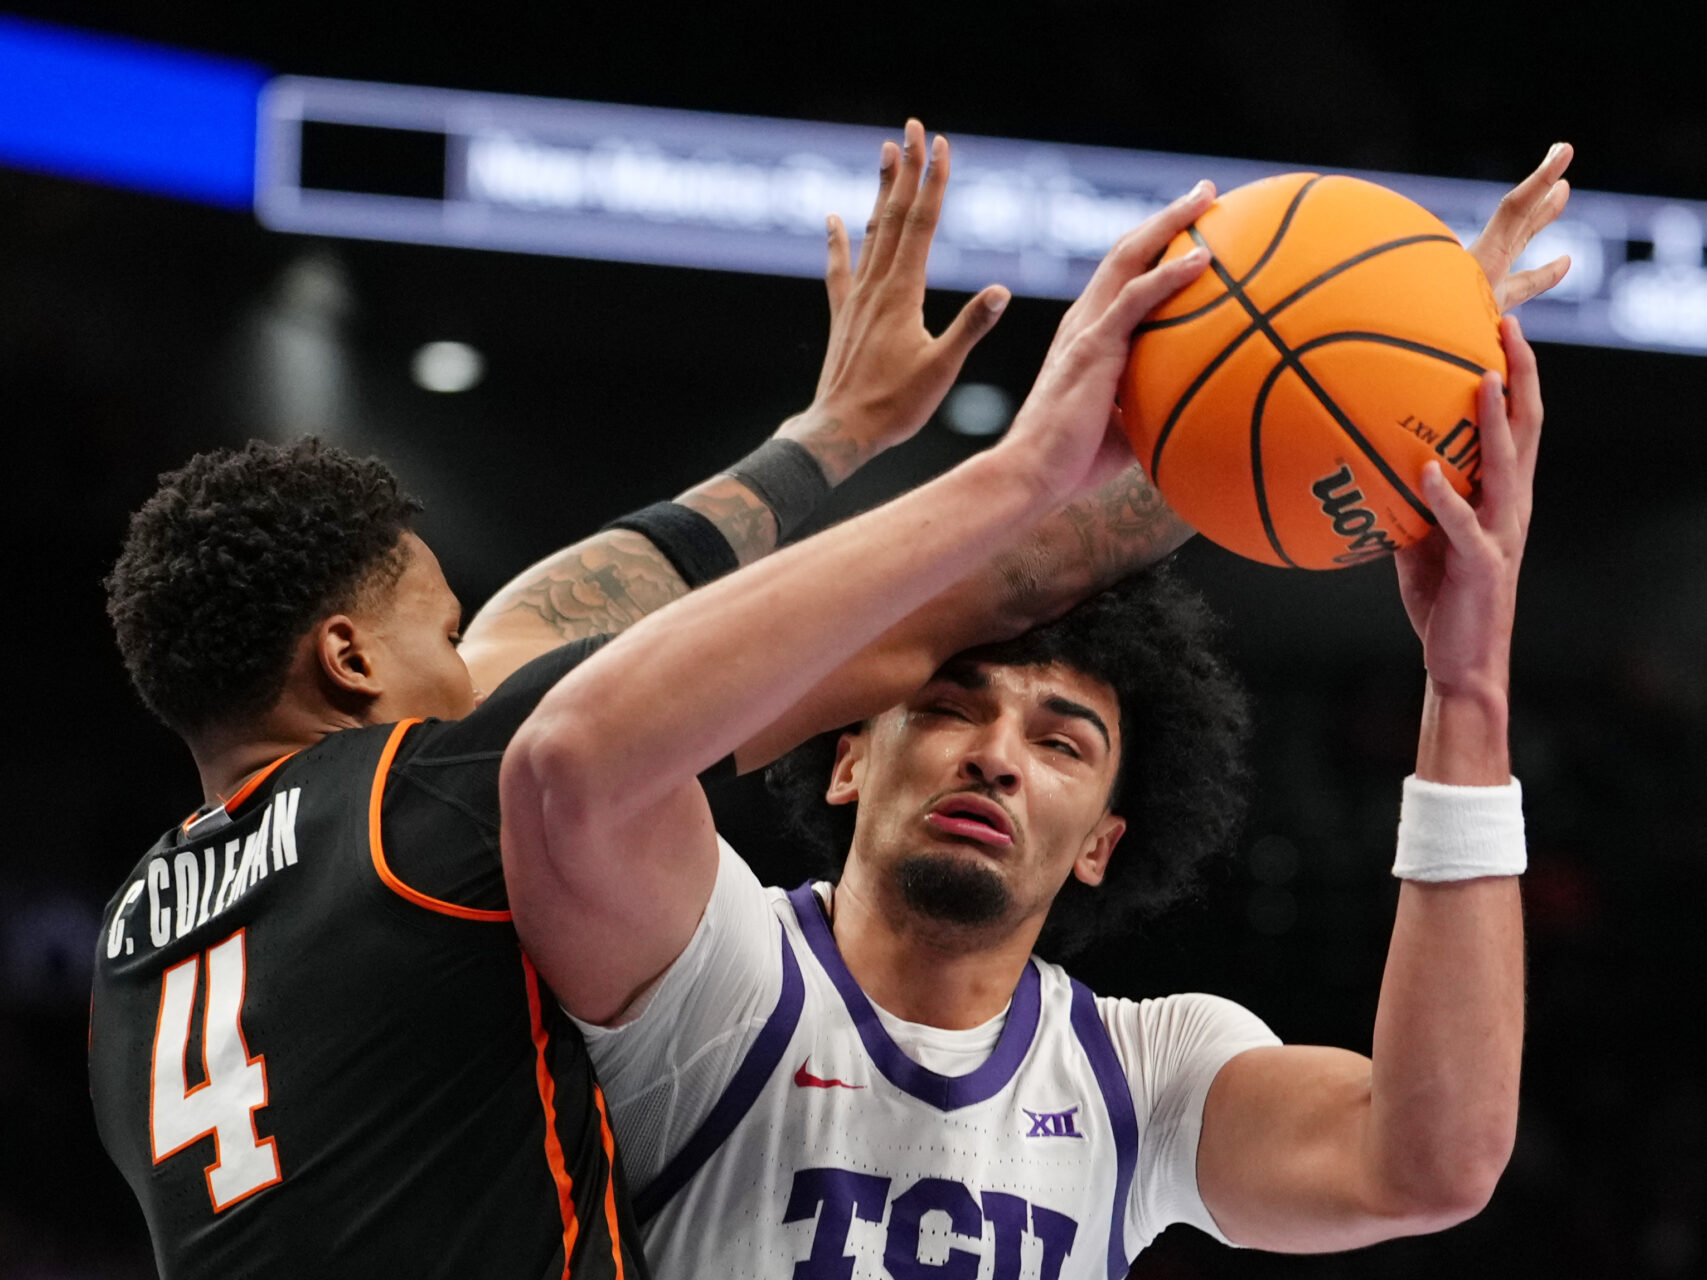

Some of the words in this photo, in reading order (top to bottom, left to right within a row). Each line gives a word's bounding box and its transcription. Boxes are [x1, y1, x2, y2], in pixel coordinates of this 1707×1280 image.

[1396, 415, 1437, 444] NXT
[1312, 464, 1397, 563] lson
[107, 879, 145, 959] C.
[148, 787, 301, 947] COLEMAN
[150, 928, 282, 1214] 4
[1023, 1106, 1084, 1139] XII
